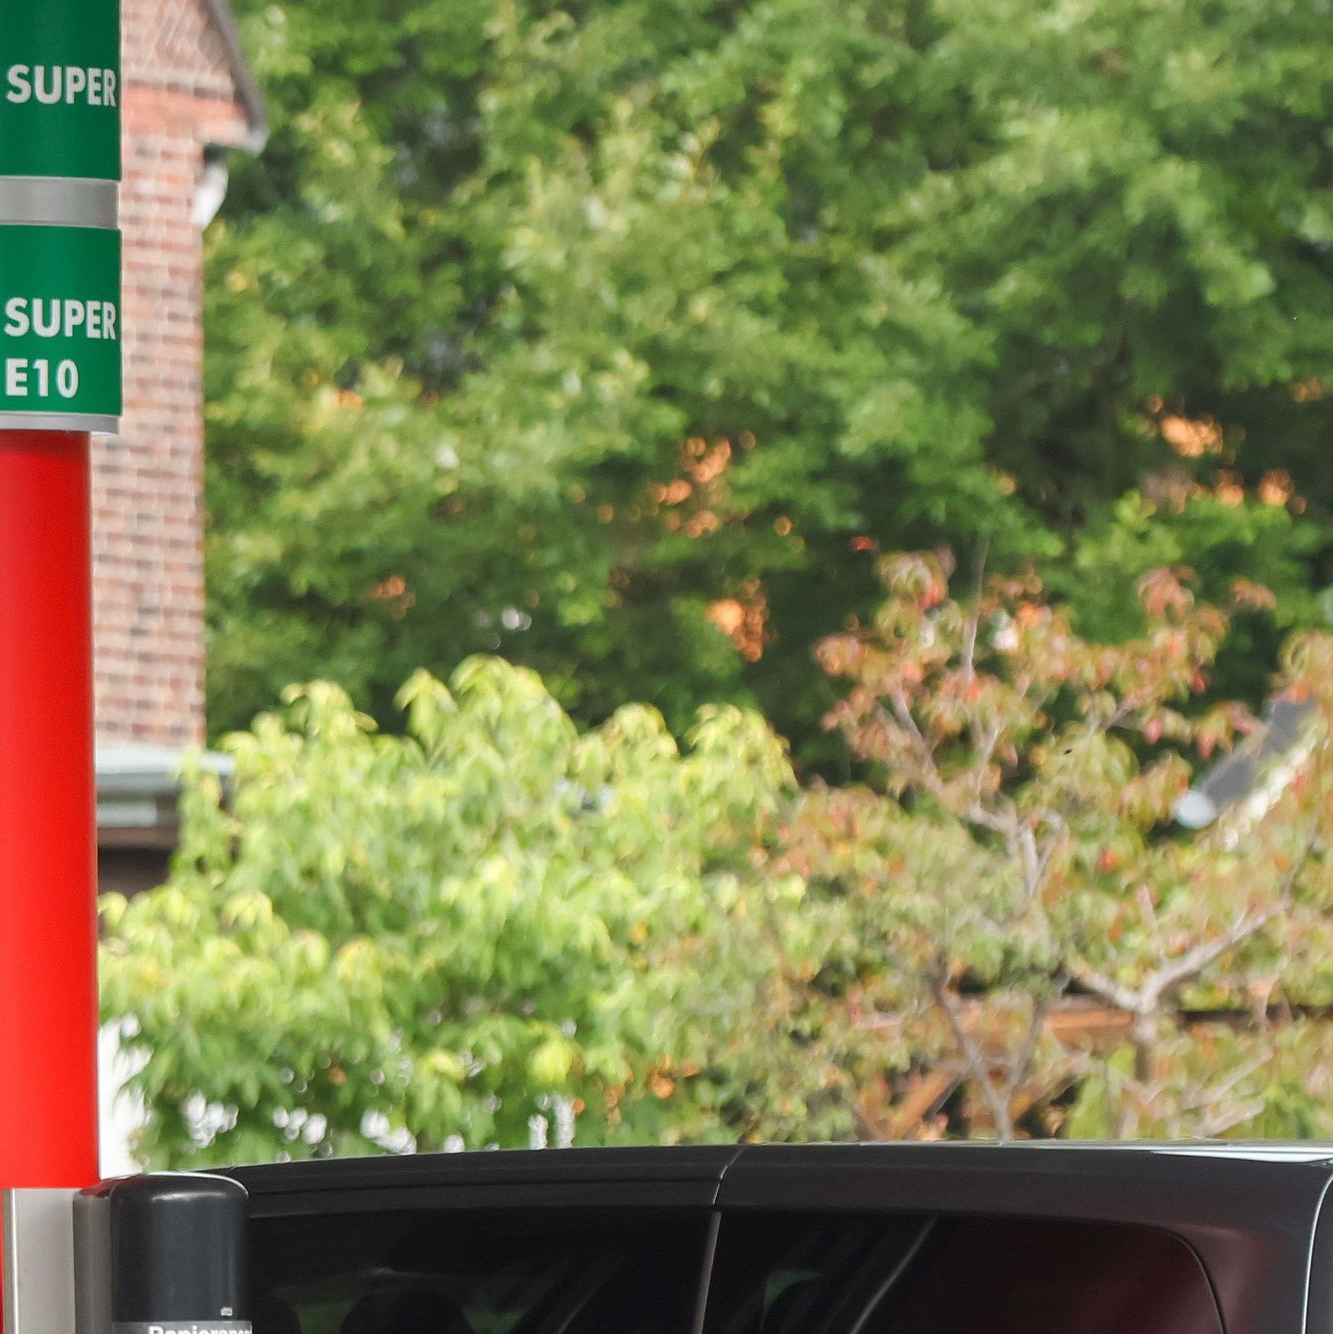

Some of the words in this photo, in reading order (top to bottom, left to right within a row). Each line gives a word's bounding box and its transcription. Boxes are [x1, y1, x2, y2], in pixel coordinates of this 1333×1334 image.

[5, 64, 117, 107] SUPER
[4, 297, 117, 340] SUPER
[5, 358, 79, 399] E10
